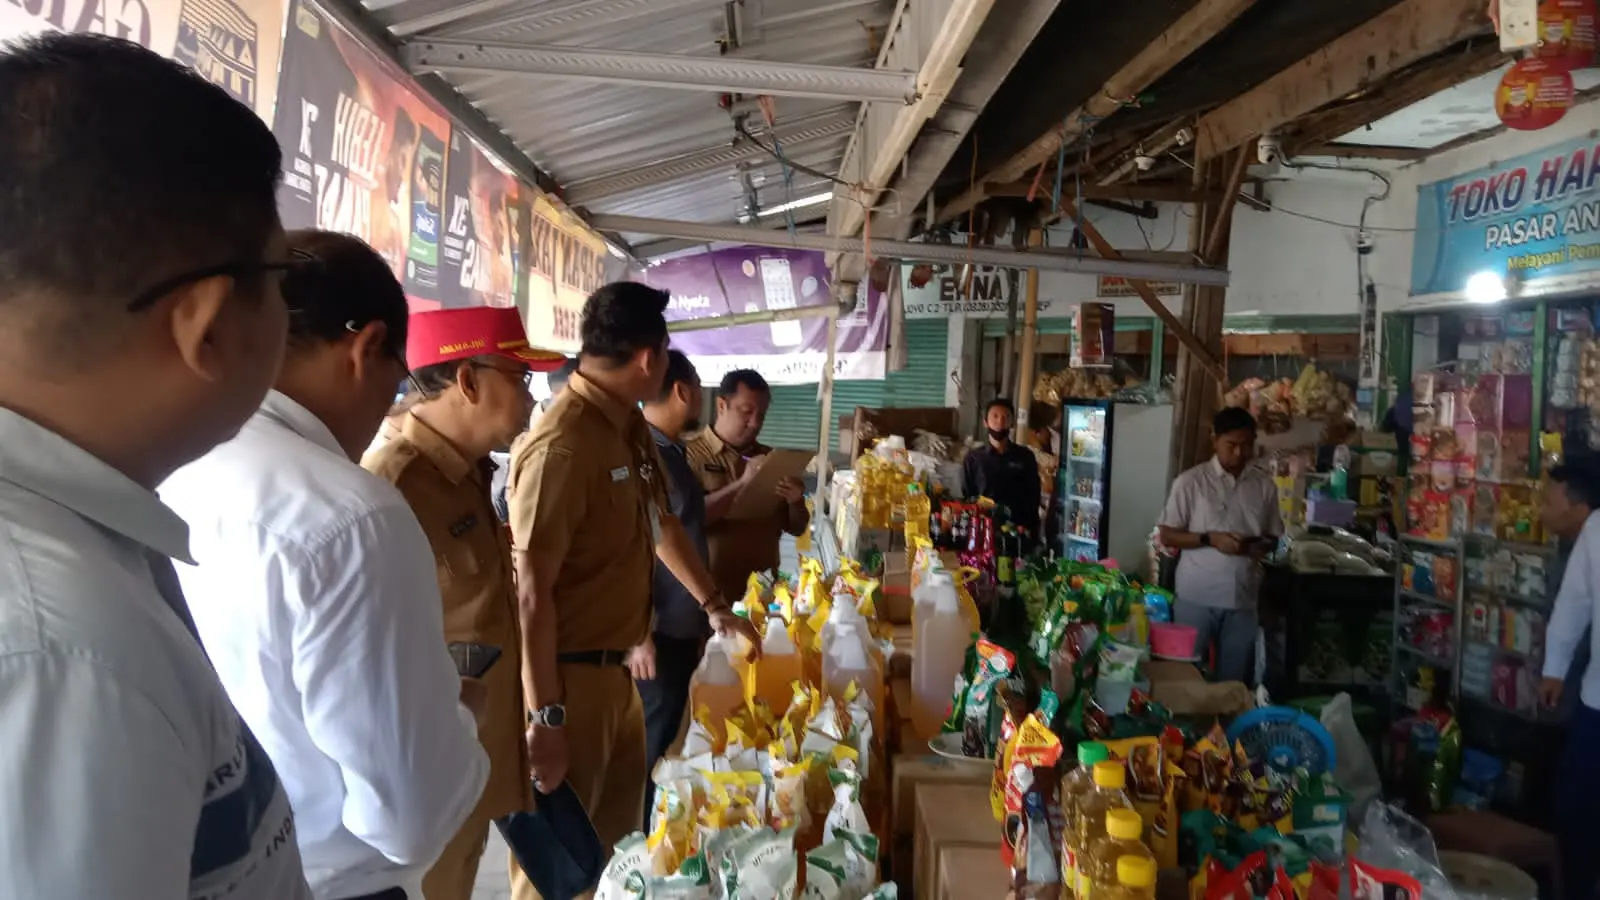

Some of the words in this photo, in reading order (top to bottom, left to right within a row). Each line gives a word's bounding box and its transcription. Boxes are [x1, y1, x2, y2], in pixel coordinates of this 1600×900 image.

[1449, 167, 1527, 222] TOKO
[1485, 213, 1558, 250] PASAR
[1562, 202, 1600, 234] AN
[1507, 246, 1565, 270] Melayani
